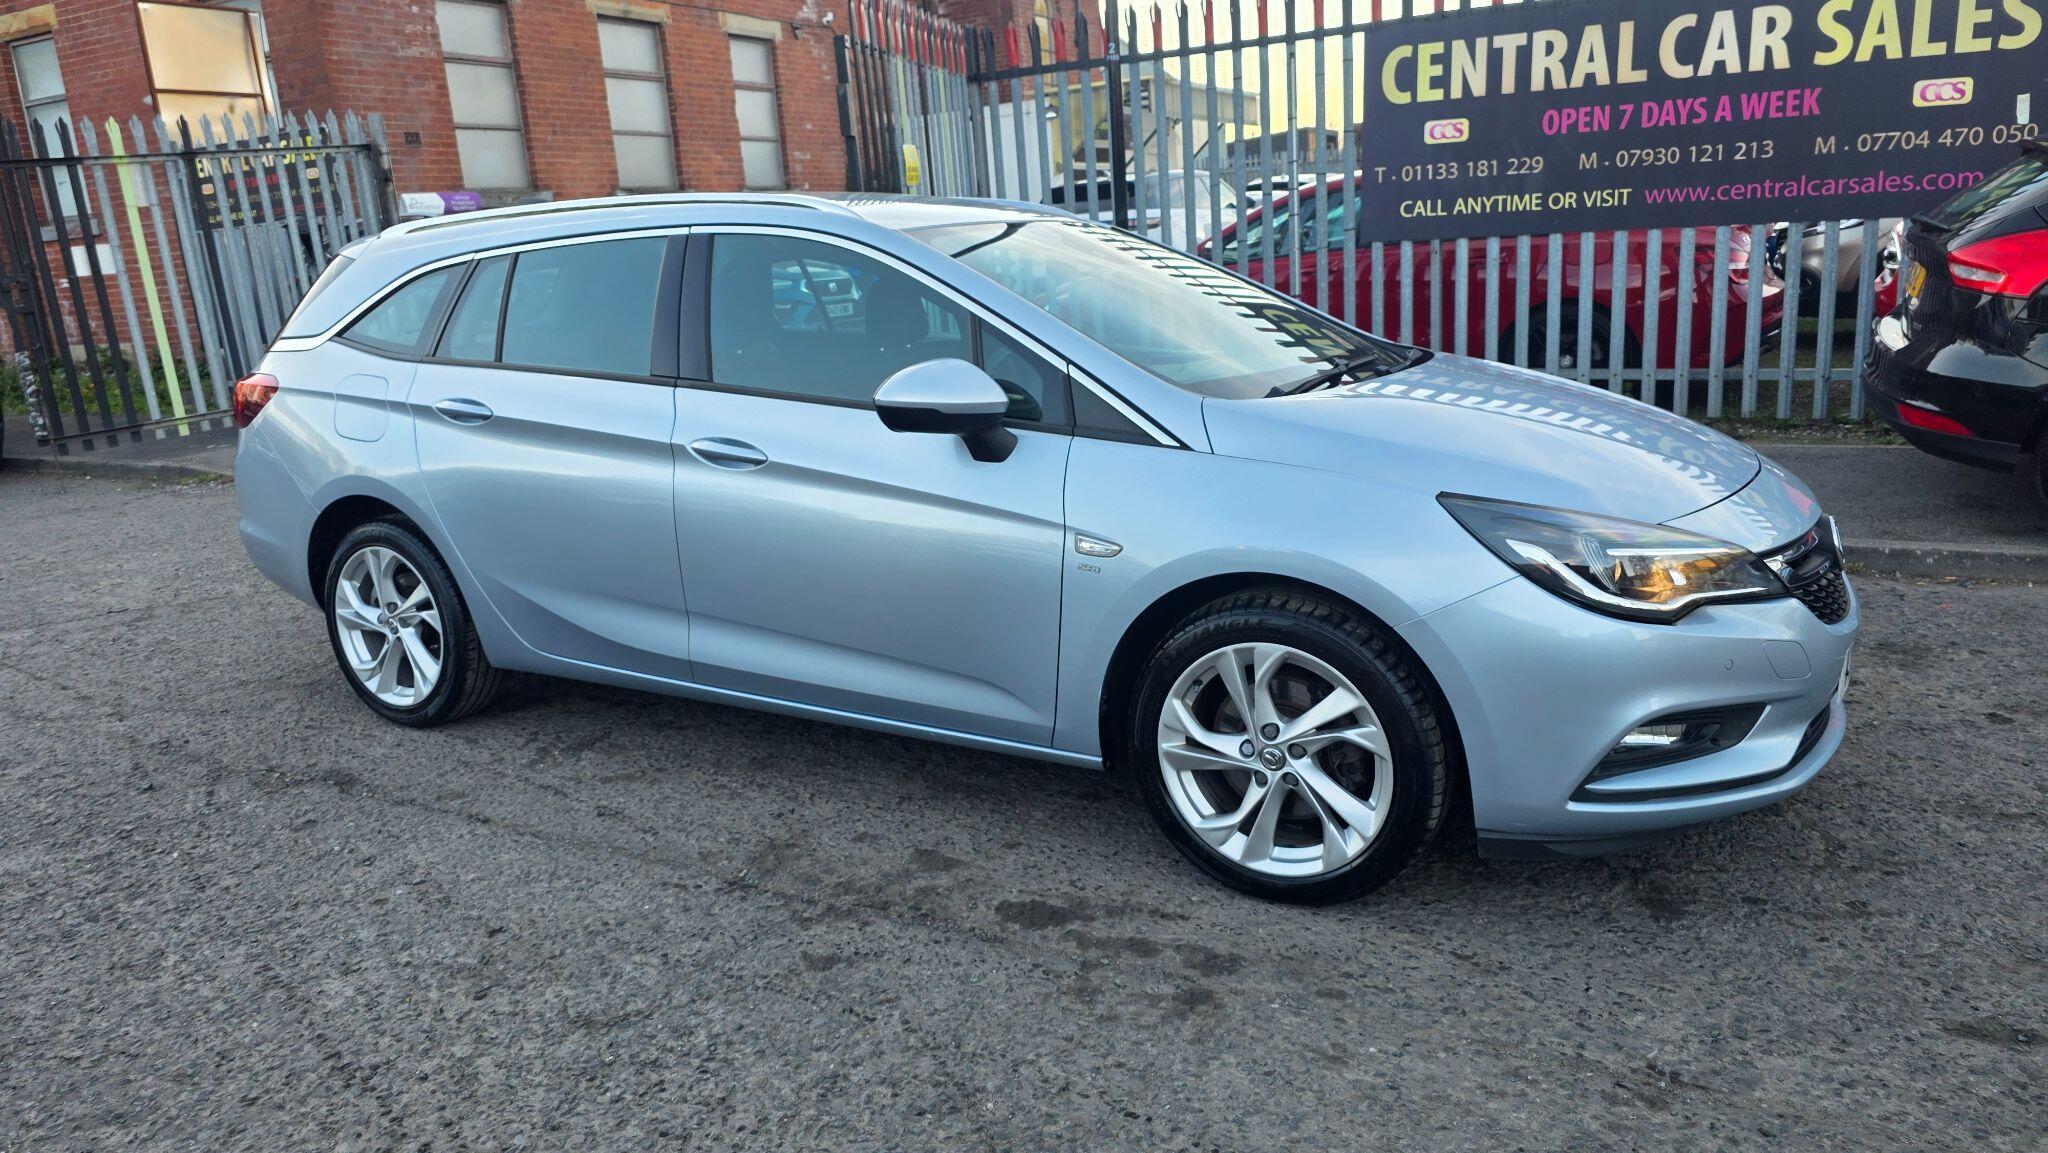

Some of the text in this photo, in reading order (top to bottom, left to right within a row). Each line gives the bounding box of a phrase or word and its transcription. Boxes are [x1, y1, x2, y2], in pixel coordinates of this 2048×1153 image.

[1382, 0, 2043, 105] CENTRAL CAR SALES
[1542, 87, 1823, 136] OPEN 7 DAYS A WEEK
[1615, 147, 1680, 168] 07930
[1689, 143, 1724, 163] 121
[1733, 140, 1774, 161] 213
[1857, 130, 1930, 153] 07704
[1938, 126, 1984, 148] 470
[1992, 123, 2039, 145] 050
[1401, 161, 1458, 182] 01133
[1466, 159, 1498, 178] 181
[1506, 156, 1544, 175] 229
[1400, 170, 1985, 218] CALL ANYTIME OR VISIT www.centralcarsales.com
